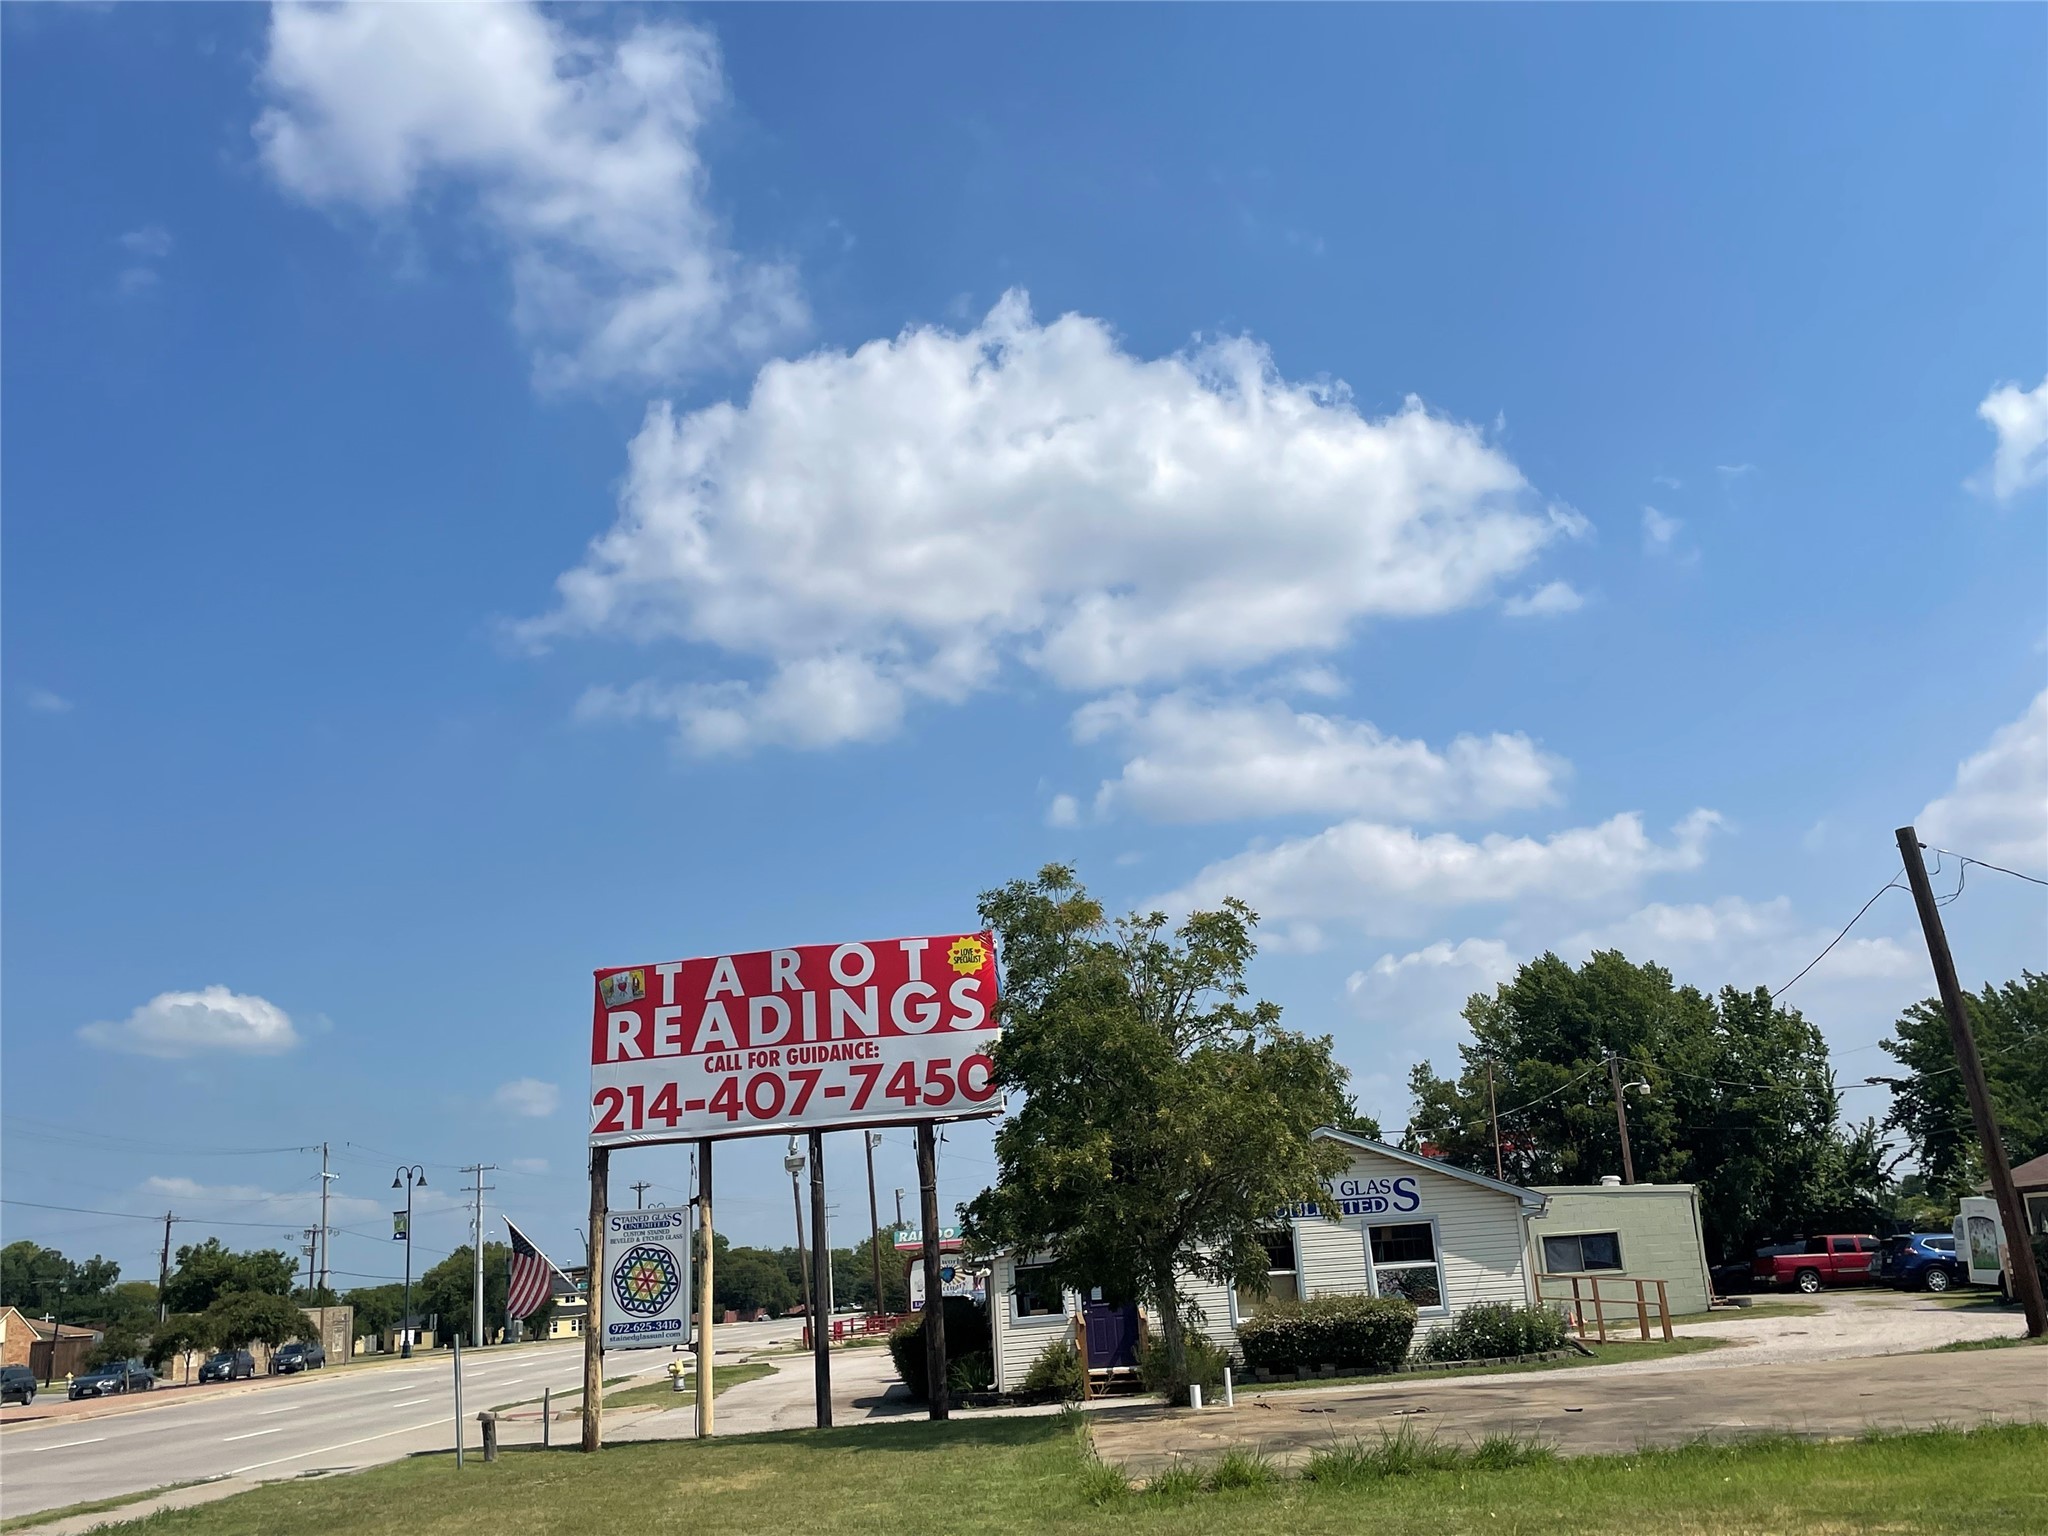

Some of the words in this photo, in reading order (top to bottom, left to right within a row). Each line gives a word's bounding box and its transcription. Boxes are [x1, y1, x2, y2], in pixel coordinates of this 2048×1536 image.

[960, 948, 973, 956] LOVE
[953, 955, 981, 964] SPECIALIST
[655, 939, 929, 1005] TAROT
[607, 977, 986, 1060] READINGS
[704, 1054, 742, 1073] CALL
[748, 1051, 780, 1069] FOR
[786, 1041, 880, 1066] GUIDANCE:
[591, 1054, 998, 1134] 214-407-7450
[611, 1216, 649, 1232] STAINED
[652, 1212, 682, 1226] GLASS
[624, 1222, 668, 1230] UNLIMITED
[610, 1237, 635, 1245] BEVELED
[611, 1320, 679, 1334] 972-625-3416
[610, 1332, 680, 1342] stainedglassunlcom
